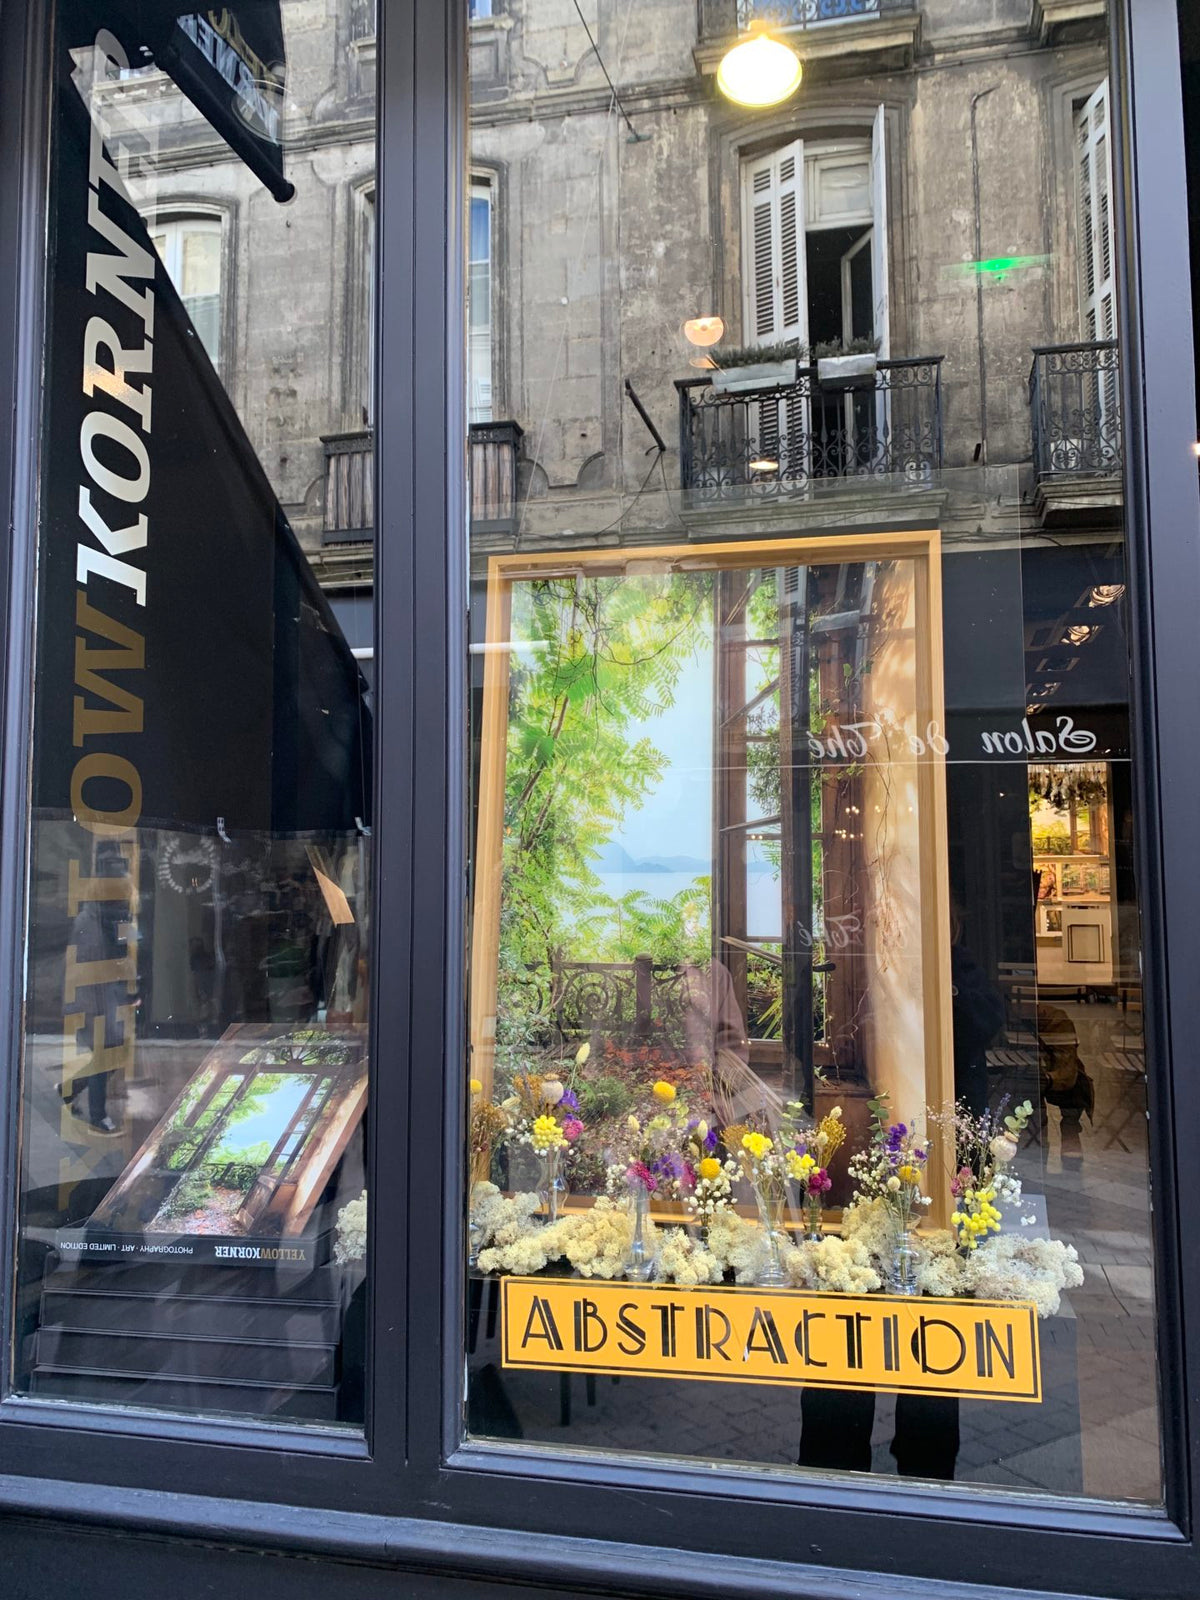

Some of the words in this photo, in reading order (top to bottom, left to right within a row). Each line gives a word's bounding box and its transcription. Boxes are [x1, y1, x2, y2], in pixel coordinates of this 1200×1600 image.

[60, 1241, 88, 1250] EDITION
[89, 1242, 117, 1251] LIMITED
[121, 1243, 135, 1252] ART
[140, 1244, 194, 1255] PHOTOGRAPHY
[520, 1294, 1016, 1380] ABSTRACTION
